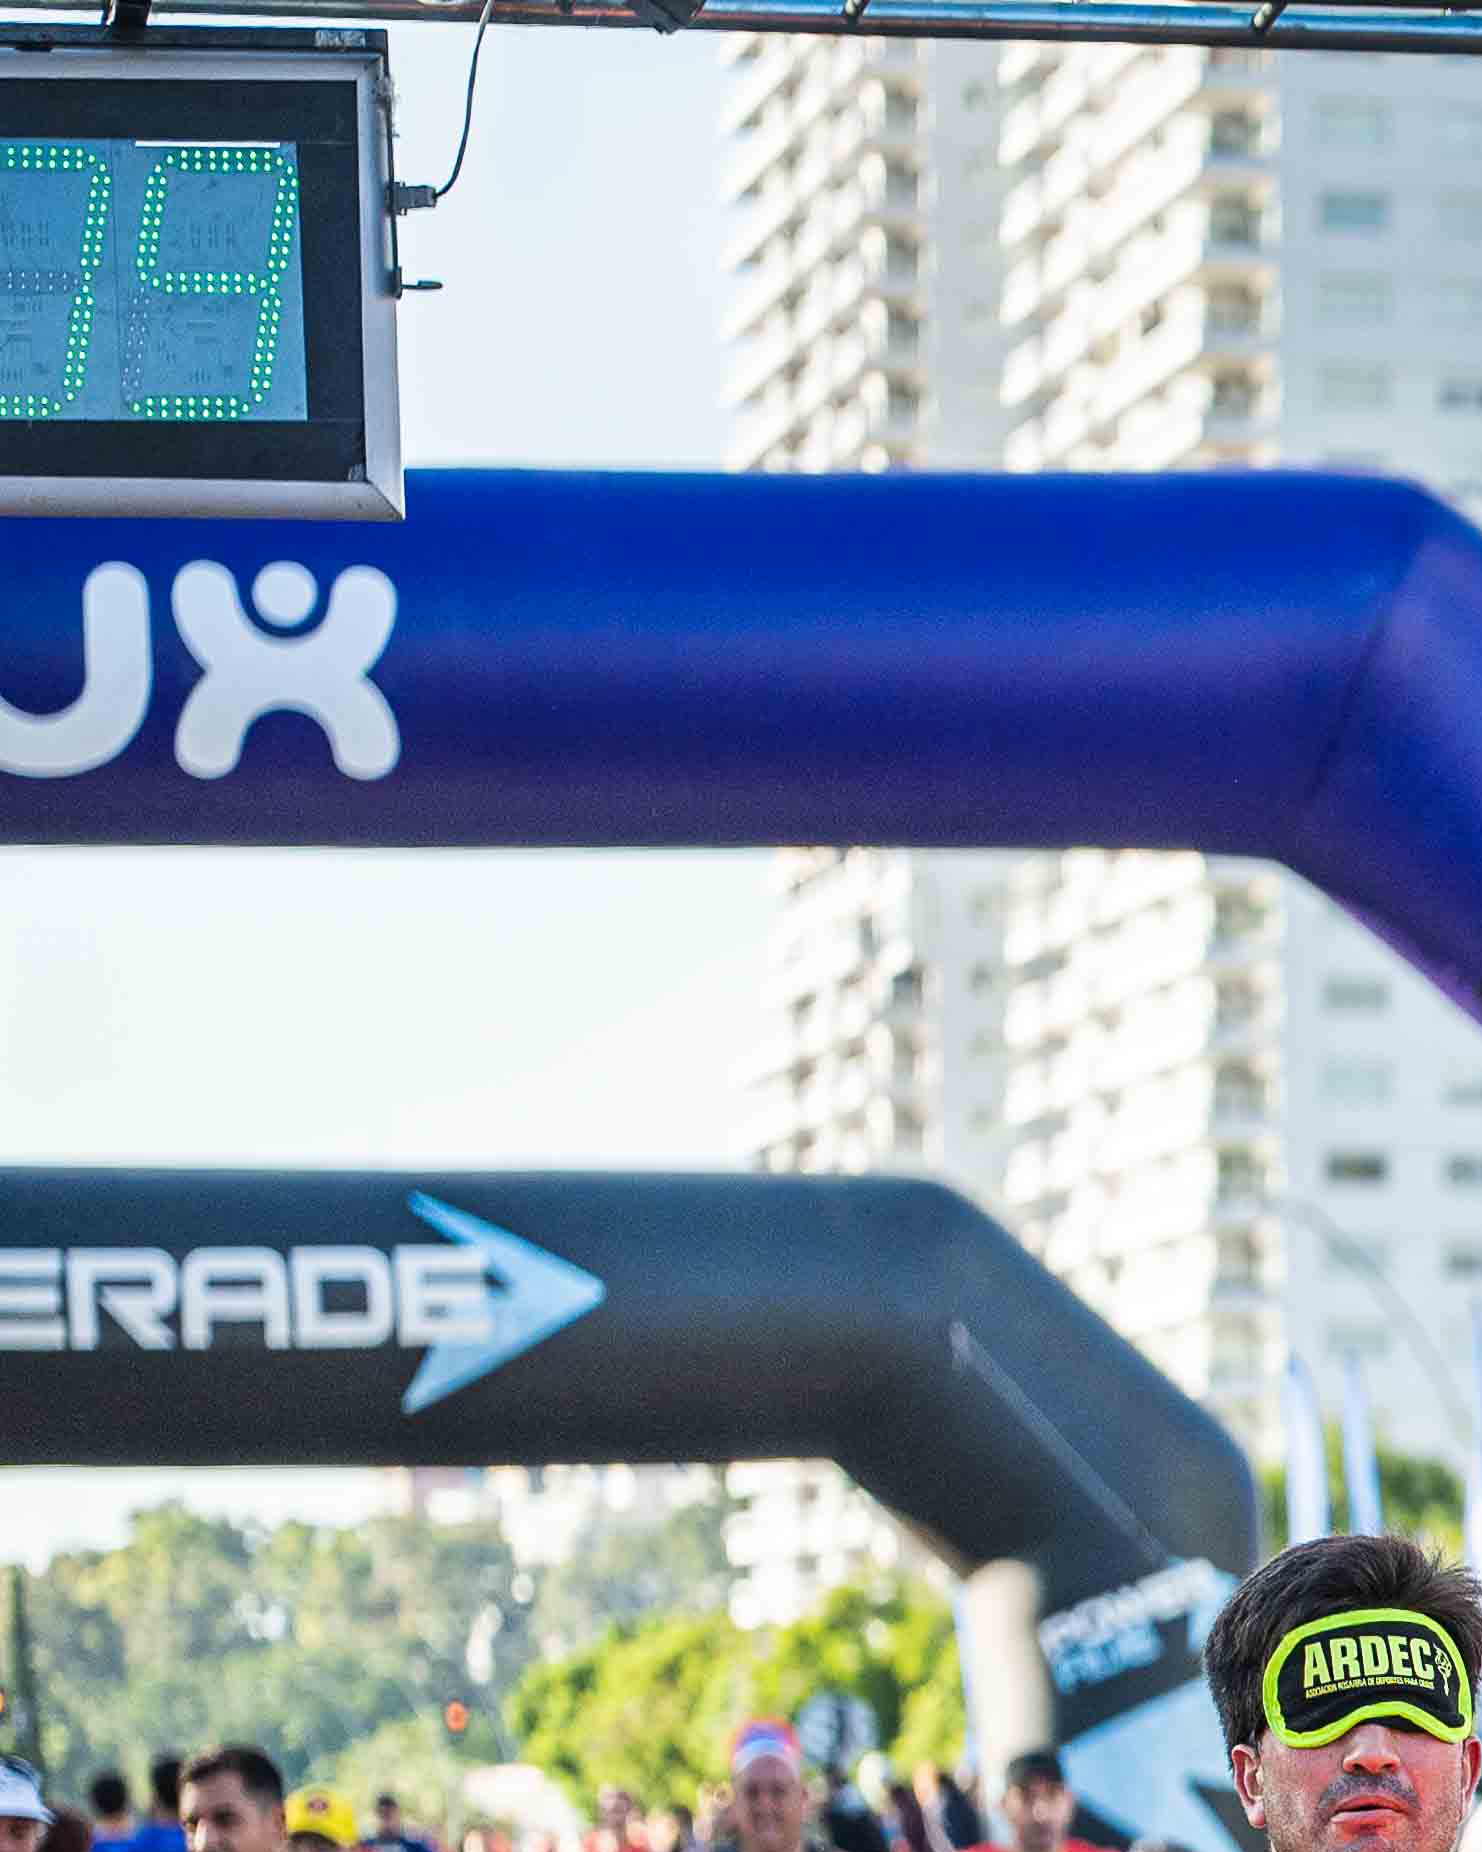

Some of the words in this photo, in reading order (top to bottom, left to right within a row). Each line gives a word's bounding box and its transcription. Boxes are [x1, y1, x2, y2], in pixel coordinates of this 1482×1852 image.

[0, 559, 402, 781] UX
[0, 1245, 492, 1351] ERADE
[1304, 1635, 1435, 1688] ARDEC
